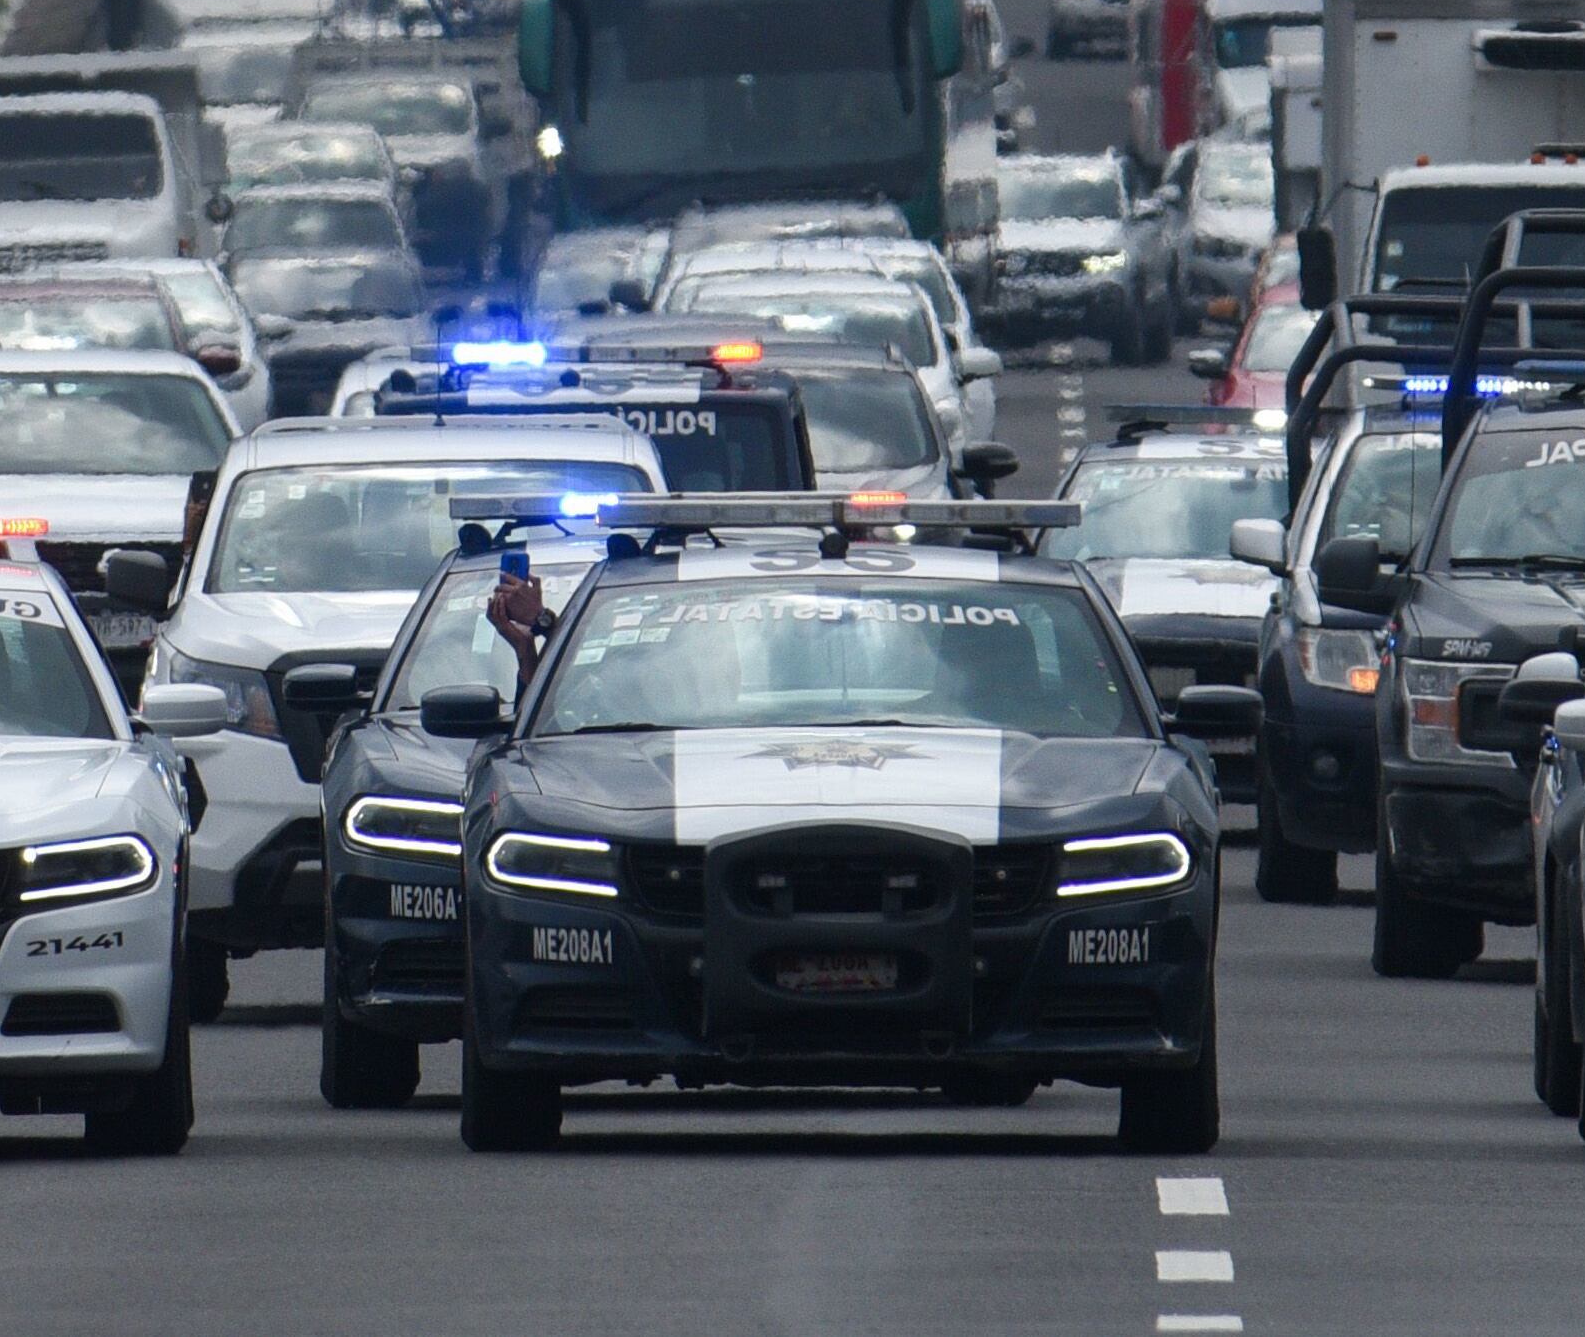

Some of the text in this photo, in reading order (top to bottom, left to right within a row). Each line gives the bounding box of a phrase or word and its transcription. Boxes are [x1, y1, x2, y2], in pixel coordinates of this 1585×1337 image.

[390, 884, 462, 920] ME206A
[26, 931, 124, 957] 21441
[532, 926, 613, 963] ME208A1
[1068, 926, 1150, 964] ME208A1
